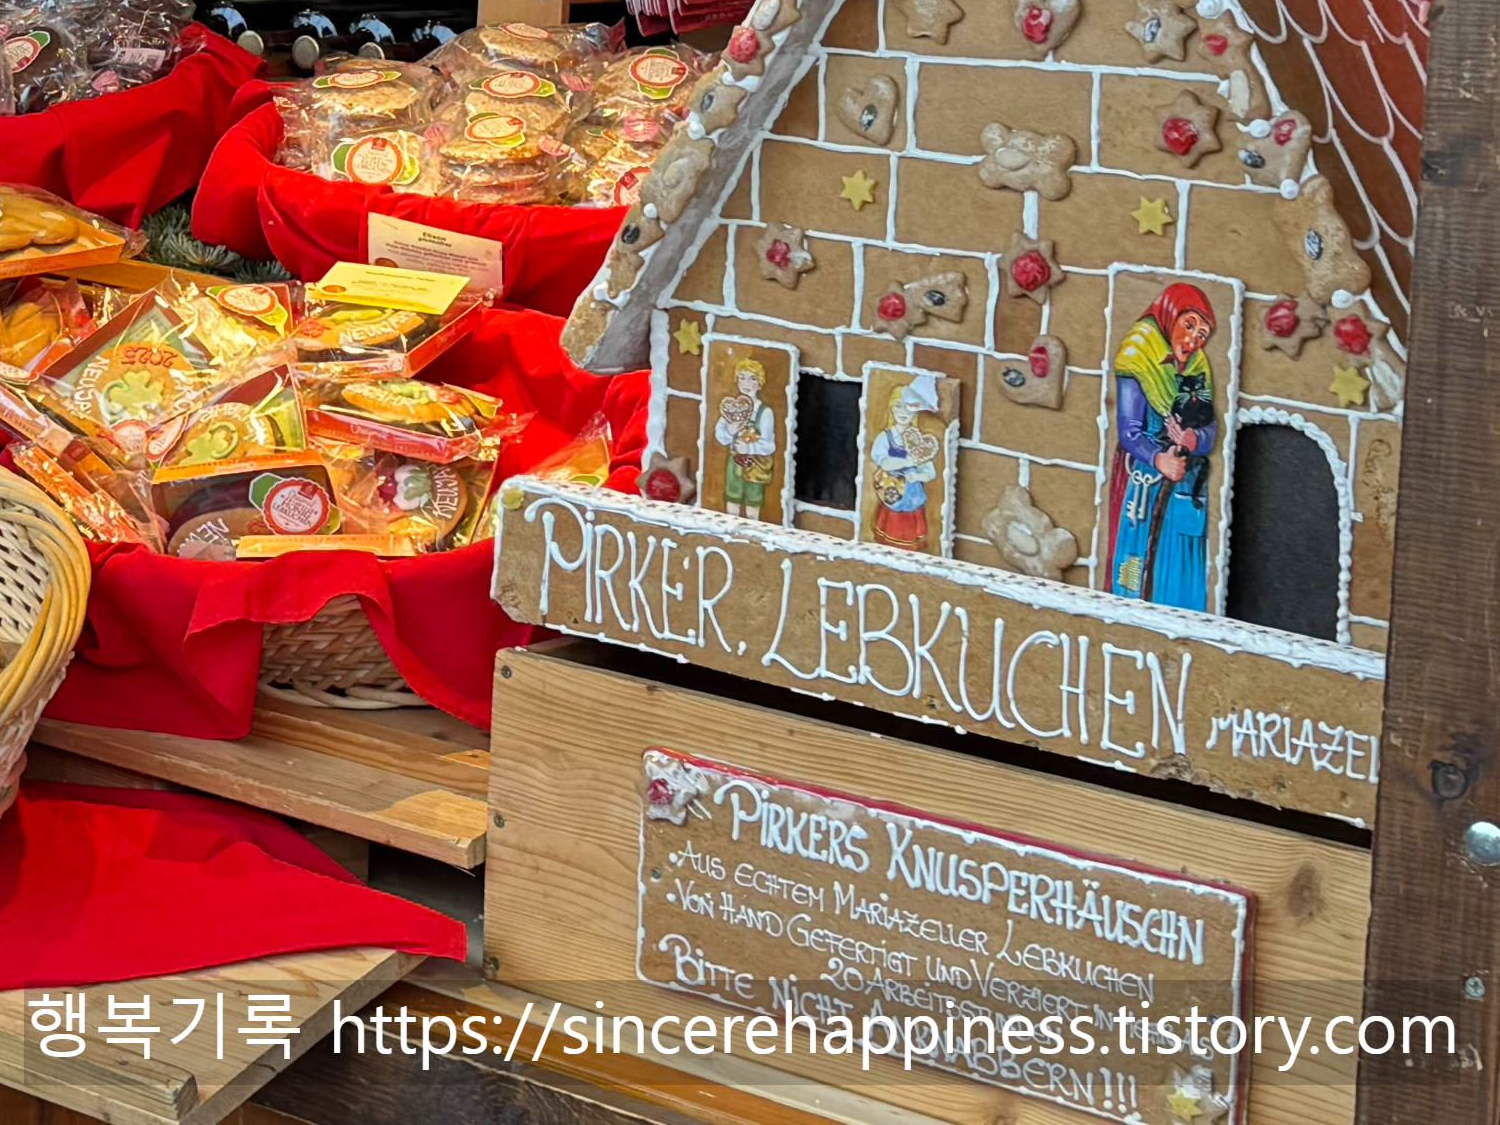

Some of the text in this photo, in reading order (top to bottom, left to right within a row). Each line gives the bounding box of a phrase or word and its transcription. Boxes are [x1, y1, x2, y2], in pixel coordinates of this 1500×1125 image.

[761, 557, 1192, 759] LEBKUCHEN
[713, 779, 871, 873] PIRKERS
[658, 933, 755, 999] BITTE
[768, 973, 854, 1025] NICHT
[675, 877, 715, 919] VON
[719, 891, 784, 938] HAND
[786, 912, 918, 977] GEFERTIGT
[925, 955, 972, 992] UND
[969, 958, 1089, 1022] VERZIERT
[677, 839, 1155, 1004] AUS ECHTEM MARIAZELLER LEBKUCHEN
[819, 956, 864, 992] 20
